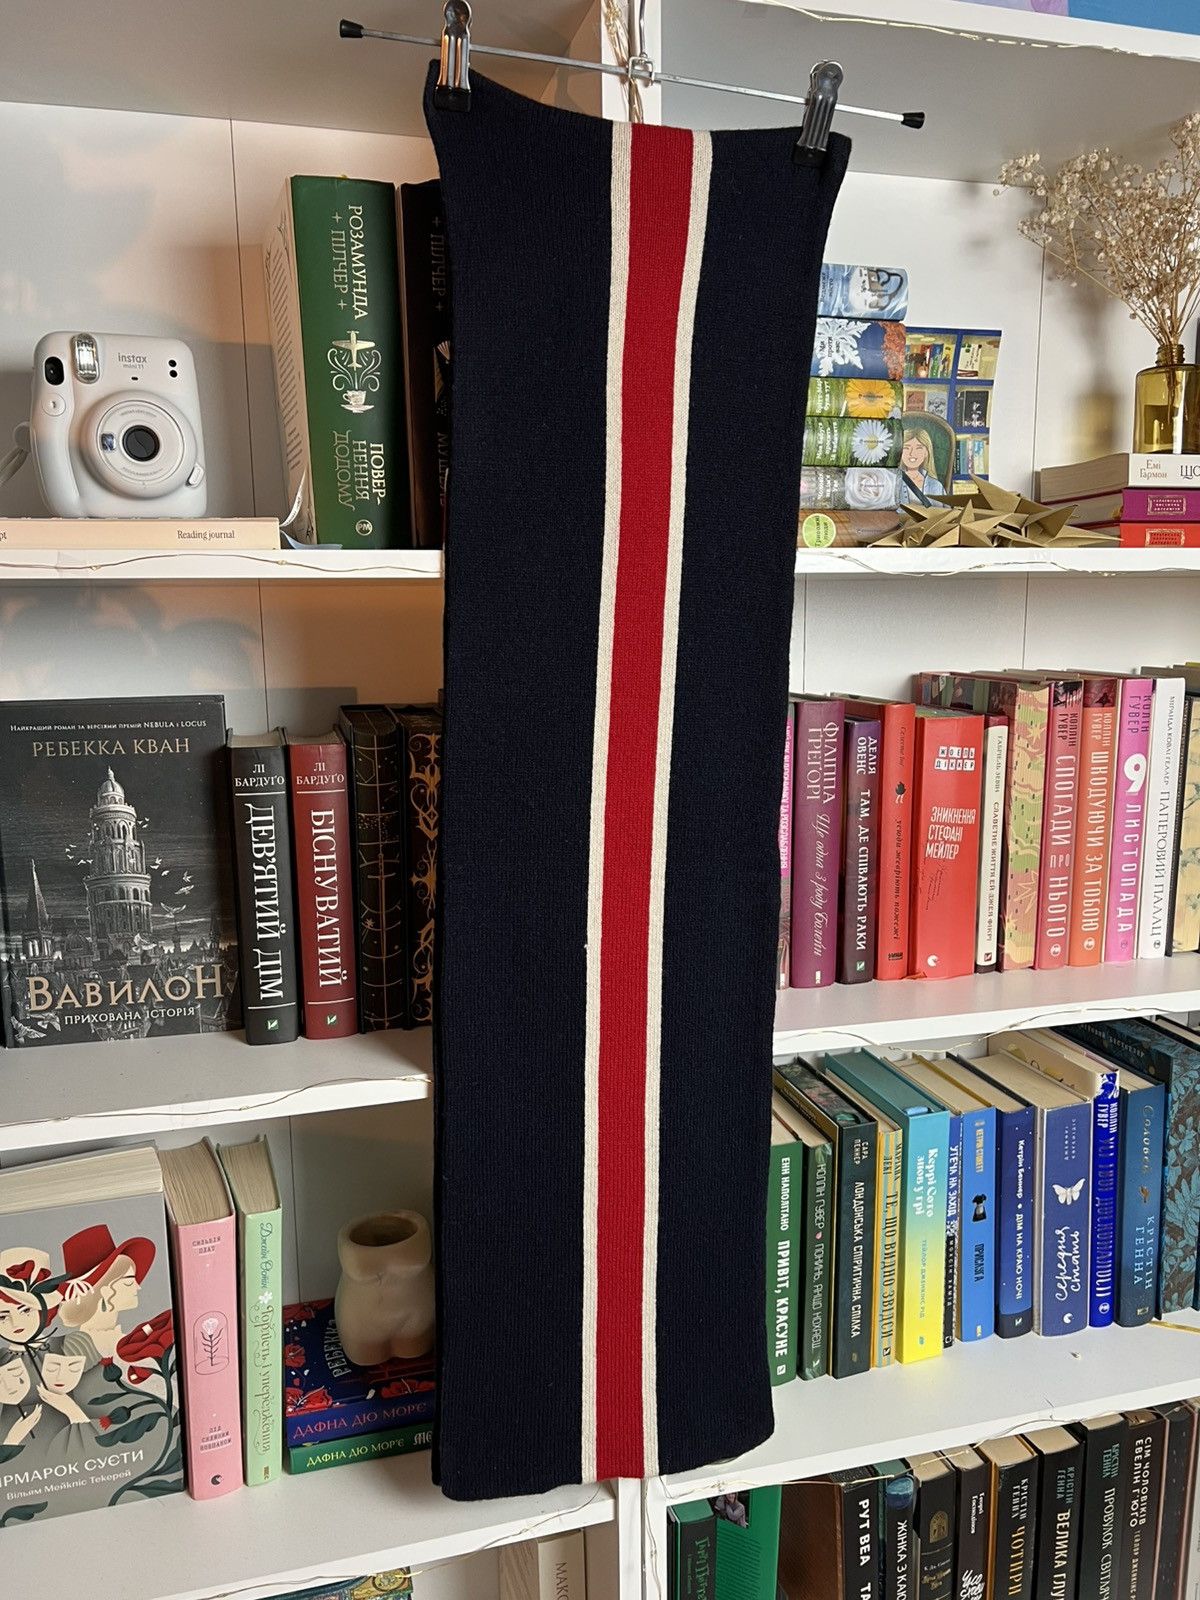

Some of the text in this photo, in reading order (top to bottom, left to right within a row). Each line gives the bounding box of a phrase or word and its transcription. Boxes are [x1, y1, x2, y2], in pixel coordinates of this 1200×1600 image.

[331, 229, 349, 294] ПІЛЧЕР
[348, 204, 369, 320] РОЗАМУНДА
[430, 233, 446, 297] ПІЛЧЕР
[118, 352, 147, 363] instax
[333, 430, 355, 512] ДОДОМУ
[352, 440, 370, 501] НЕННЯ
[370, 442, 387, 506] ПОВЕР-
[1139, 468, 1168, 480] Гармон
[1146, 459, 1161, 469] Емі
[177, 530, 235, 543] Reading journal
[1057, 713, 1069, 740] ГУВЕР
[1069, 713, 1078, 747] КОЛЛІН
[1091, 713, 1102, 741] ГУВЕР
[1102, 712, 1112, 747] КОЛЛІН
[1127, 695, 1141, 734] ГУВЕР
[33, 738, 190, 757] РЕБЕККА КВАН
[313, 762, 326, 772] ЛІ
[821, 721, 840, 804] ФІЛІППА
[856, 736, 867, 775] ОВЕНС
[868, 736, 878, 774] ДЕЛІЯ
[935, 758, 975, 770] ДІККЕР
[939, 746, 975, 758] ЖОЕЛЬ
[235, 775, 285, 788] БАРДУҐО
[252, 763, 266, 773] ЛІ
[296, 774, 345, 785] БАРДУҐО
[1124, 753, 1147, 793] 9
[930, 806, 977, 825] ЗНИКНЕННЯ
[1050, 755, 1077, 846] СПОГАДИ
[925, 842, 960, 860] МЕЙЛЕР
[927, 825, 963, 842] СТЕФАНІ
[1081, 751, 1110, 932] ШКОДУЮЧИ ЗА ТОБОЮ
[855, 789, 871, 951] ТАМ, ДЕ СПІВАЮТЬ РАКИ
[1117, 803, 1142, 933] ЛИСТОПАДА
[1150, 791, 1170, 936] ПАПЕРОВИЙ ПАЛАЦ
[244, 803, 287, 1000] ДЕВ'ЯТИЙ ДІМ
[310, 808, 348, 987] БІСНУВАТИЙ
[1046, 876, 1069, 938] НЬОГО
[26, 963, 225, 1012] ВАВИЛОН
[64, 1006, 196, 1025] ПРИХОВАНА ІСТОРІЯ
[1097, 1103, 1109, 1129] ГУВЕР
[1109, 1101, 1118, 1134] КОЛЛІН
[853, 1138, 861, 1165] ПЕННЕР
[861, 1141, 869, 1160] САРА
[1016, 1139, 1025, 1168] Кетрін
[780, 1157, 790, 1231] ЕНН НАПОЛІТАНО
[946, 1145, 959, 1217] УТЕЧА НА ЗАХІД
[814, 1198, 826, 1229] ГУВЕР
[851, 1181, 865, 1338] ЛОНДОНСЬКА СПІРИТИЧНА СПІЛКА
[880, 1191, 899, 1339] ТЕ, ЩО ВИДНО ЗВІДСИ
[1015, 1213, 1024, 1300] ДІМ НА КРАЮ НОЧІ
[1133, 1227, 1145, 1285] ГЕННА
[1144, 1216, 1155, 1290] КРІСТІН
[774, 1240, 790, 1357] ПРИВІТ, КРАСУНЕ
[293, 1418, 348, 1440] ДАФНА
[351, 1411, 378, 1428] ДЮ
[0, 1449, 145, 1487] РМАРОК СУЄТИ
[306, 1453, 347, 1468] ДАФНА
[348, 1446, 369, 1459] ДЮ
[1102, 1448, 1112, 1478] ГЕННА
[1133, 1439, 1144, 1484] ЕВЕЛІН
[6, 1468, 132, 1500] Вільям Мейкпіс Текерей
[1020, 1478, 1029, 1520] КРІСТІН
[1056, 1469, 1067, 1500] ГЕННА
[1065, 1466, 1075, 1504] КРІСТІН
[1138, 1436, 1153, 1525] СІМ ЧОЛОВІКІВ
[1011, 1485, 1021, 1519] ГЕННА
[1101, 1487, 1116, 1550] ПРОВУЛОК
[858, 1498, 871, 1566] РУТ ВЕА
[896, 1519, 908, 1574] ЖІНКА З
[1054, 1510, 1071, 1569] ВЕЛИКА
[1008, 1525, 1026, 1595] ЧОТИРИ
